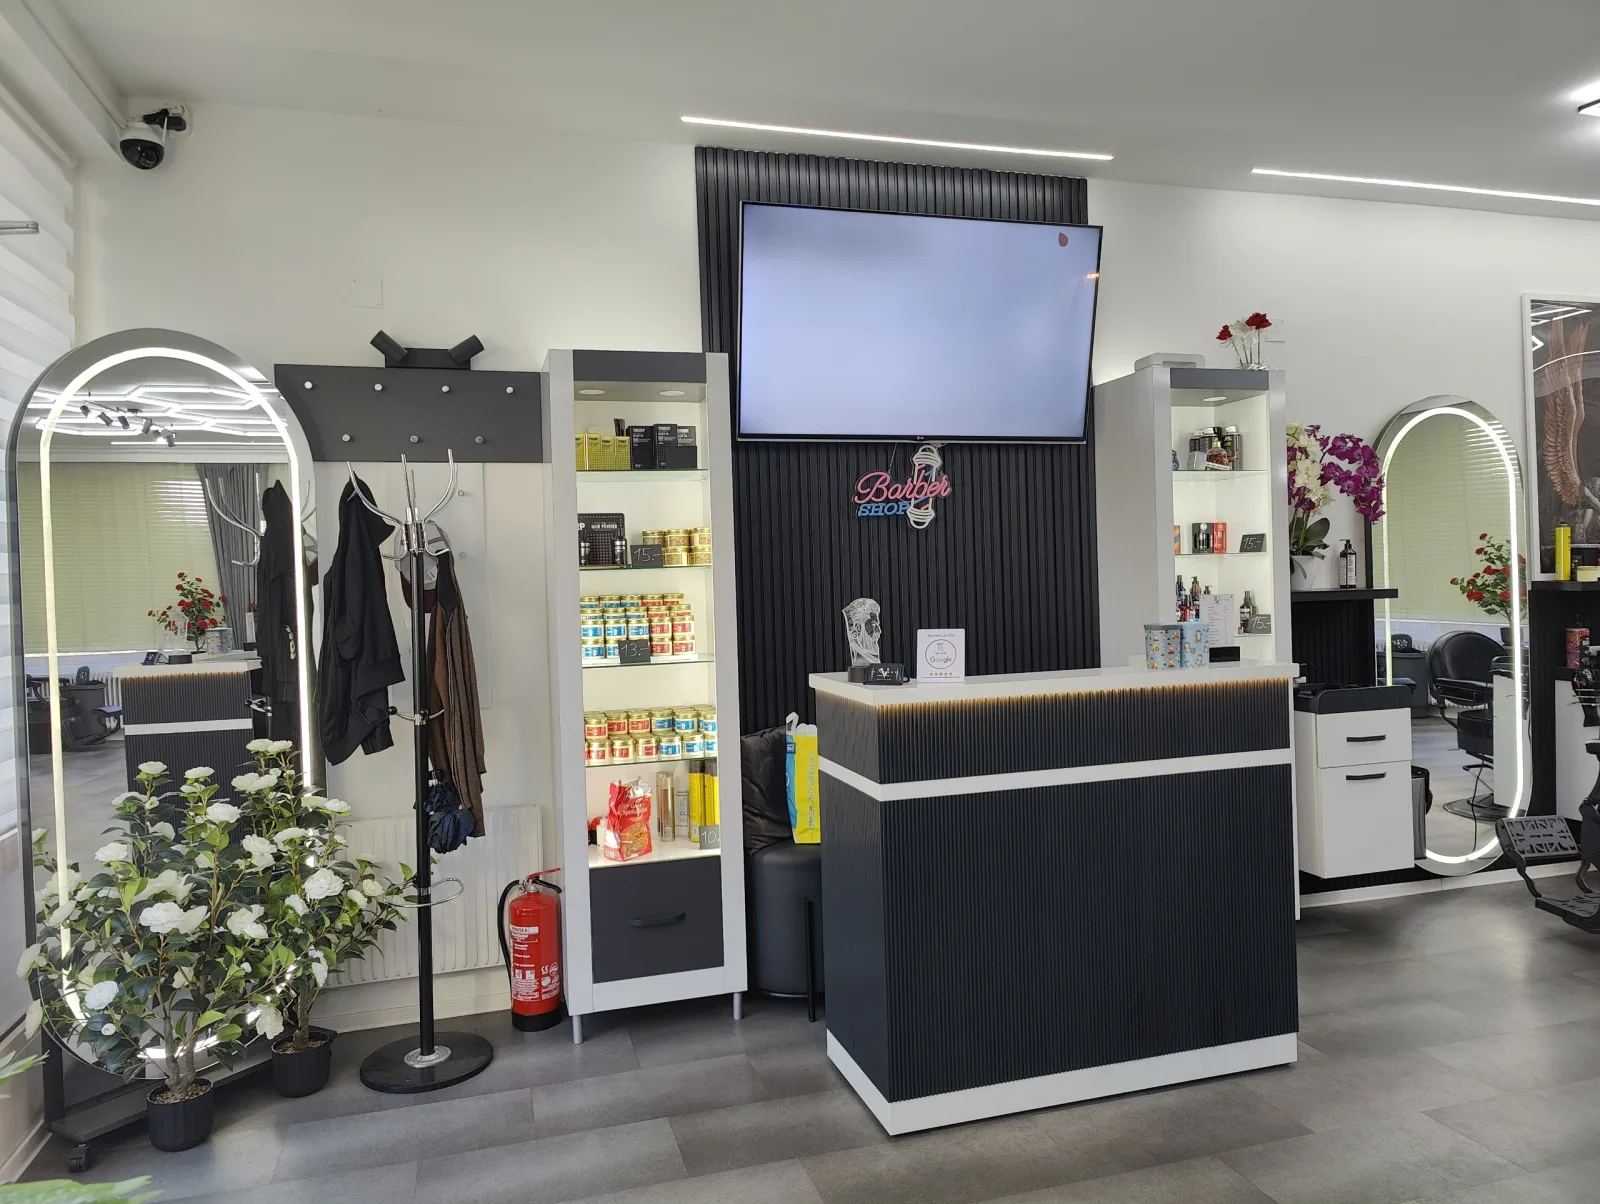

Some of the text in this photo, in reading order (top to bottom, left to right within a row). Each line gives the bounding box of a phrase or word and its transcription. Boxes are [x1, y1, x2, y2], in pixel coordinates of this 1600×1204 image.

[854, 470, 950, 503] Barber
[858, 502, 910, 517] SHOP
[634, 547, 661, 562] 15.-
[620, 643, 648, 657] 13.-
